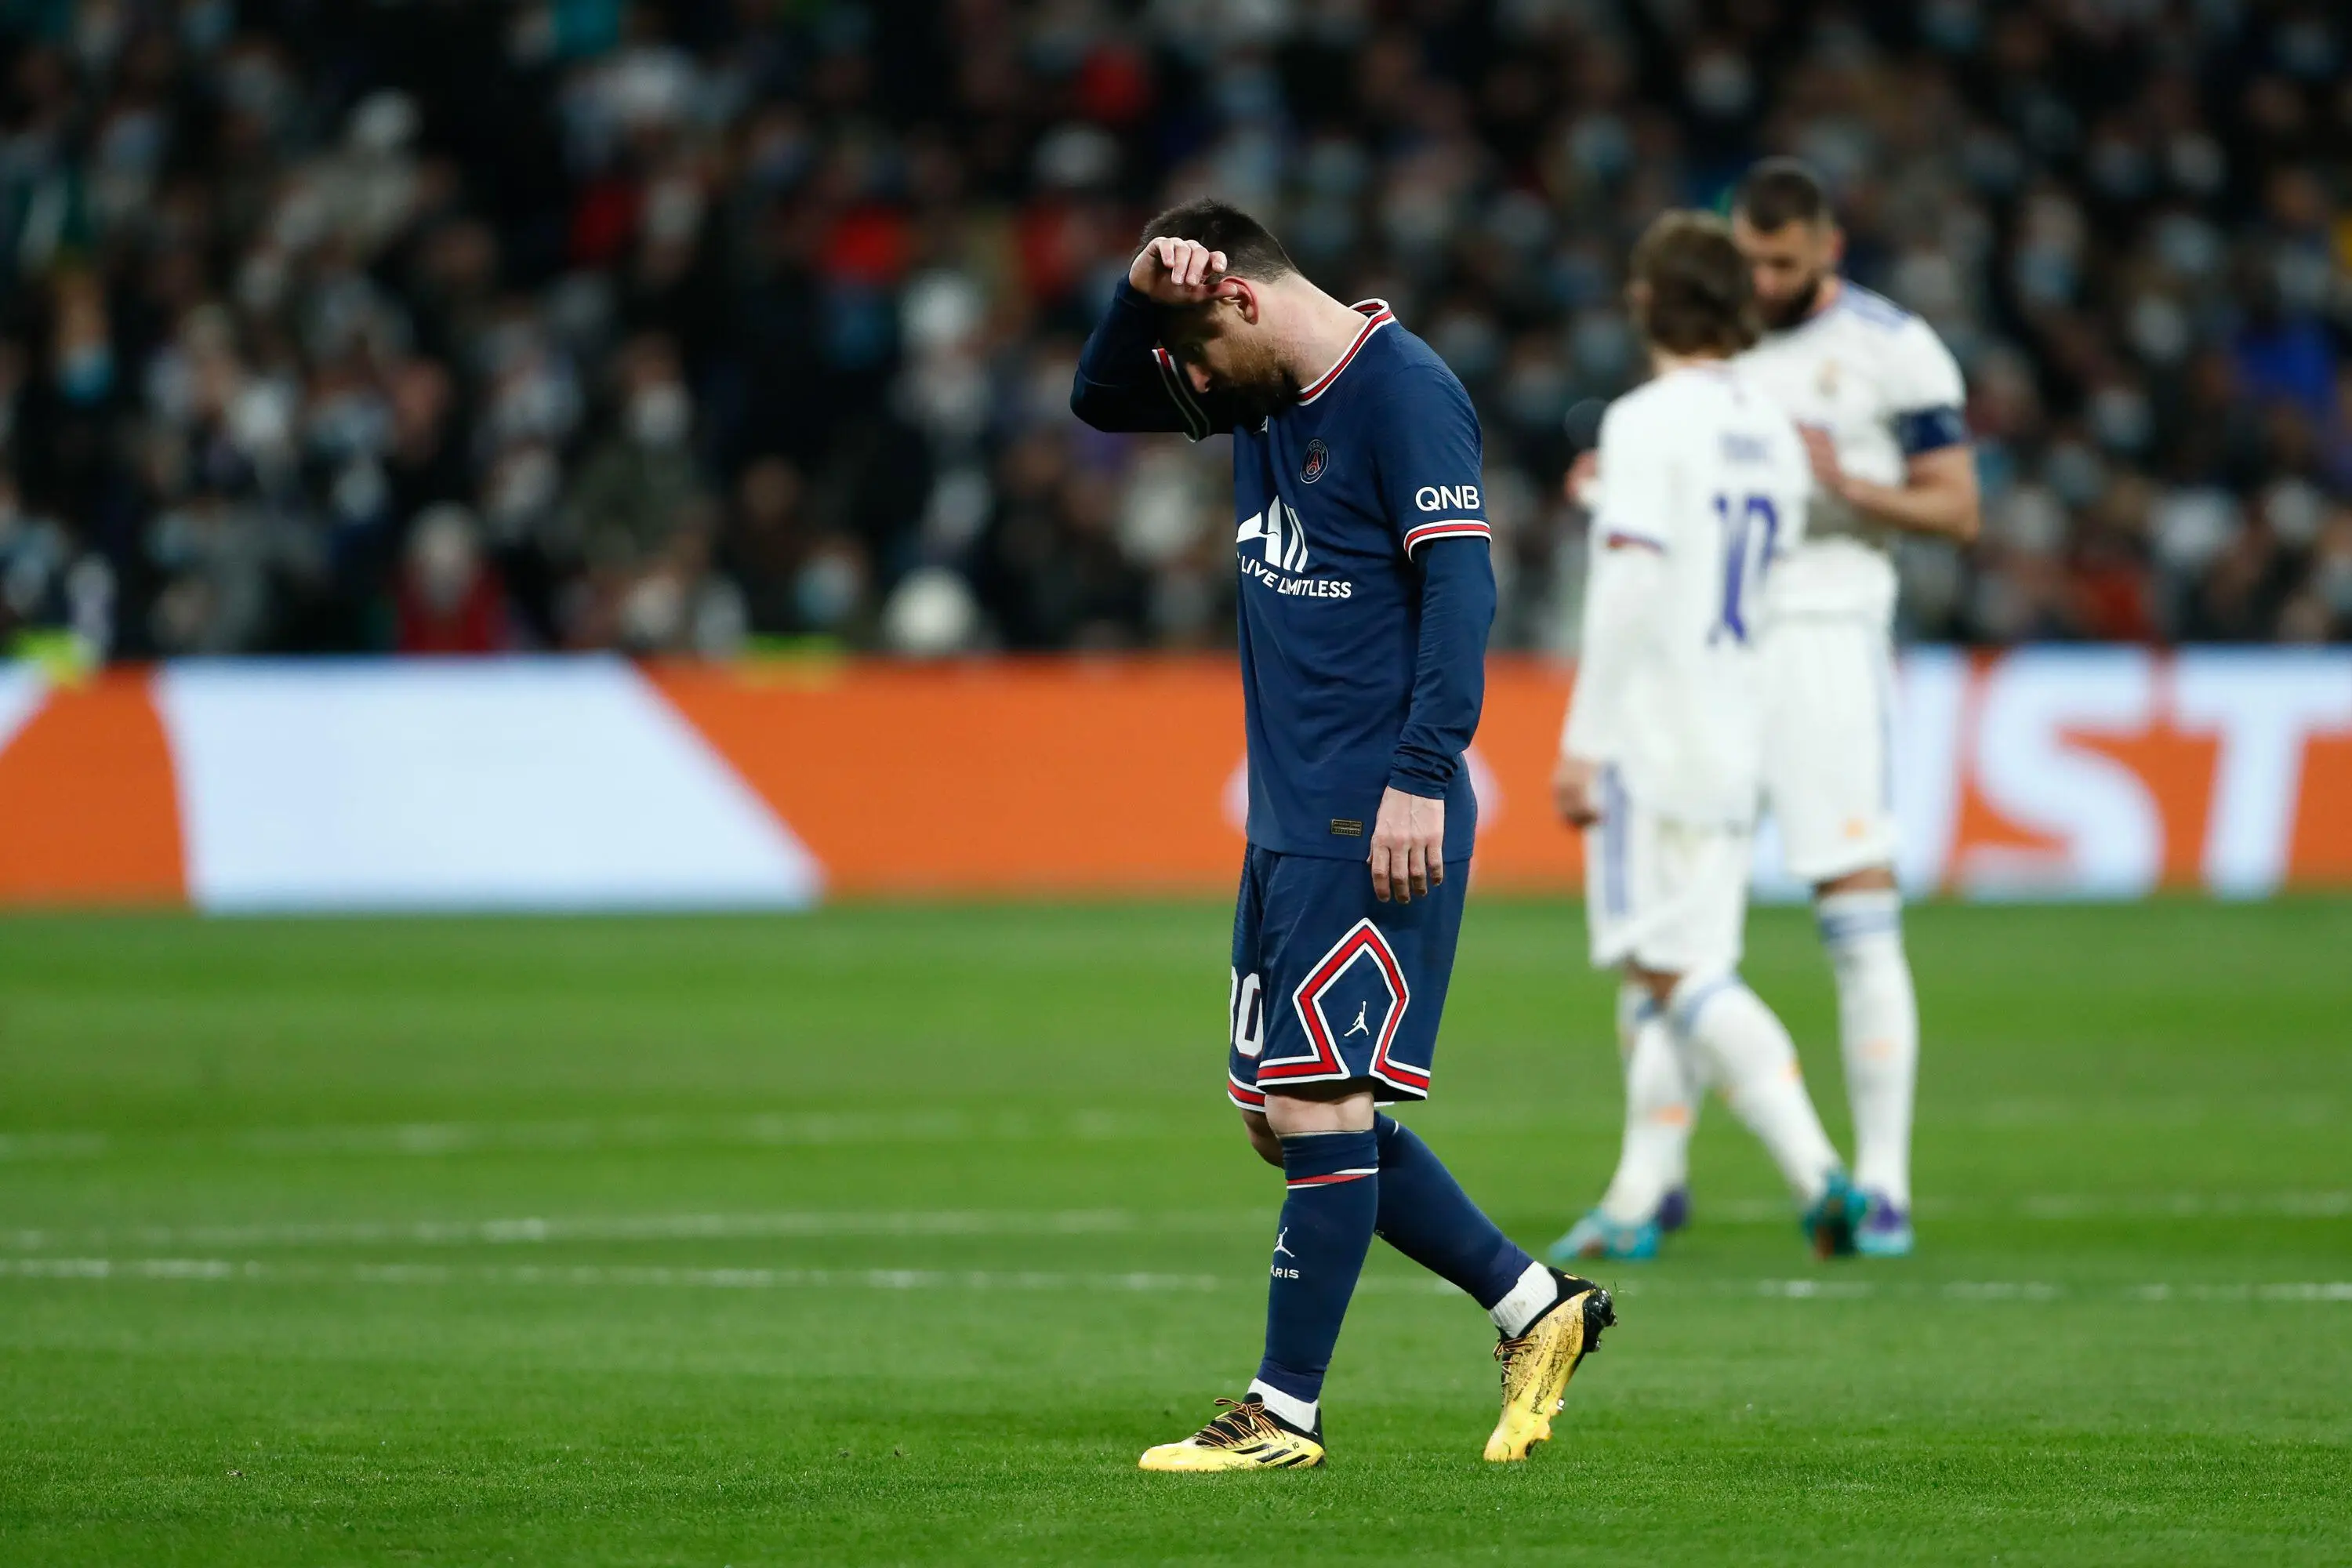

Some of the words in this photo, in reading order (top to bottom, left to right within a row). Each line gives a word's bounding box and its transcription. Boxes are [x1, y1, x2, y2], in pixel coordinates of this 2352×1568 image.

[1415, 485, 1480, 511] QNB
[1241, 555, 1279, 587] LIVE
[1229, 965, 1264, 1058] 0
[1270, 1263, 1299, 1279] ARIS
[1291, 1442, 1300, 1450] 10
